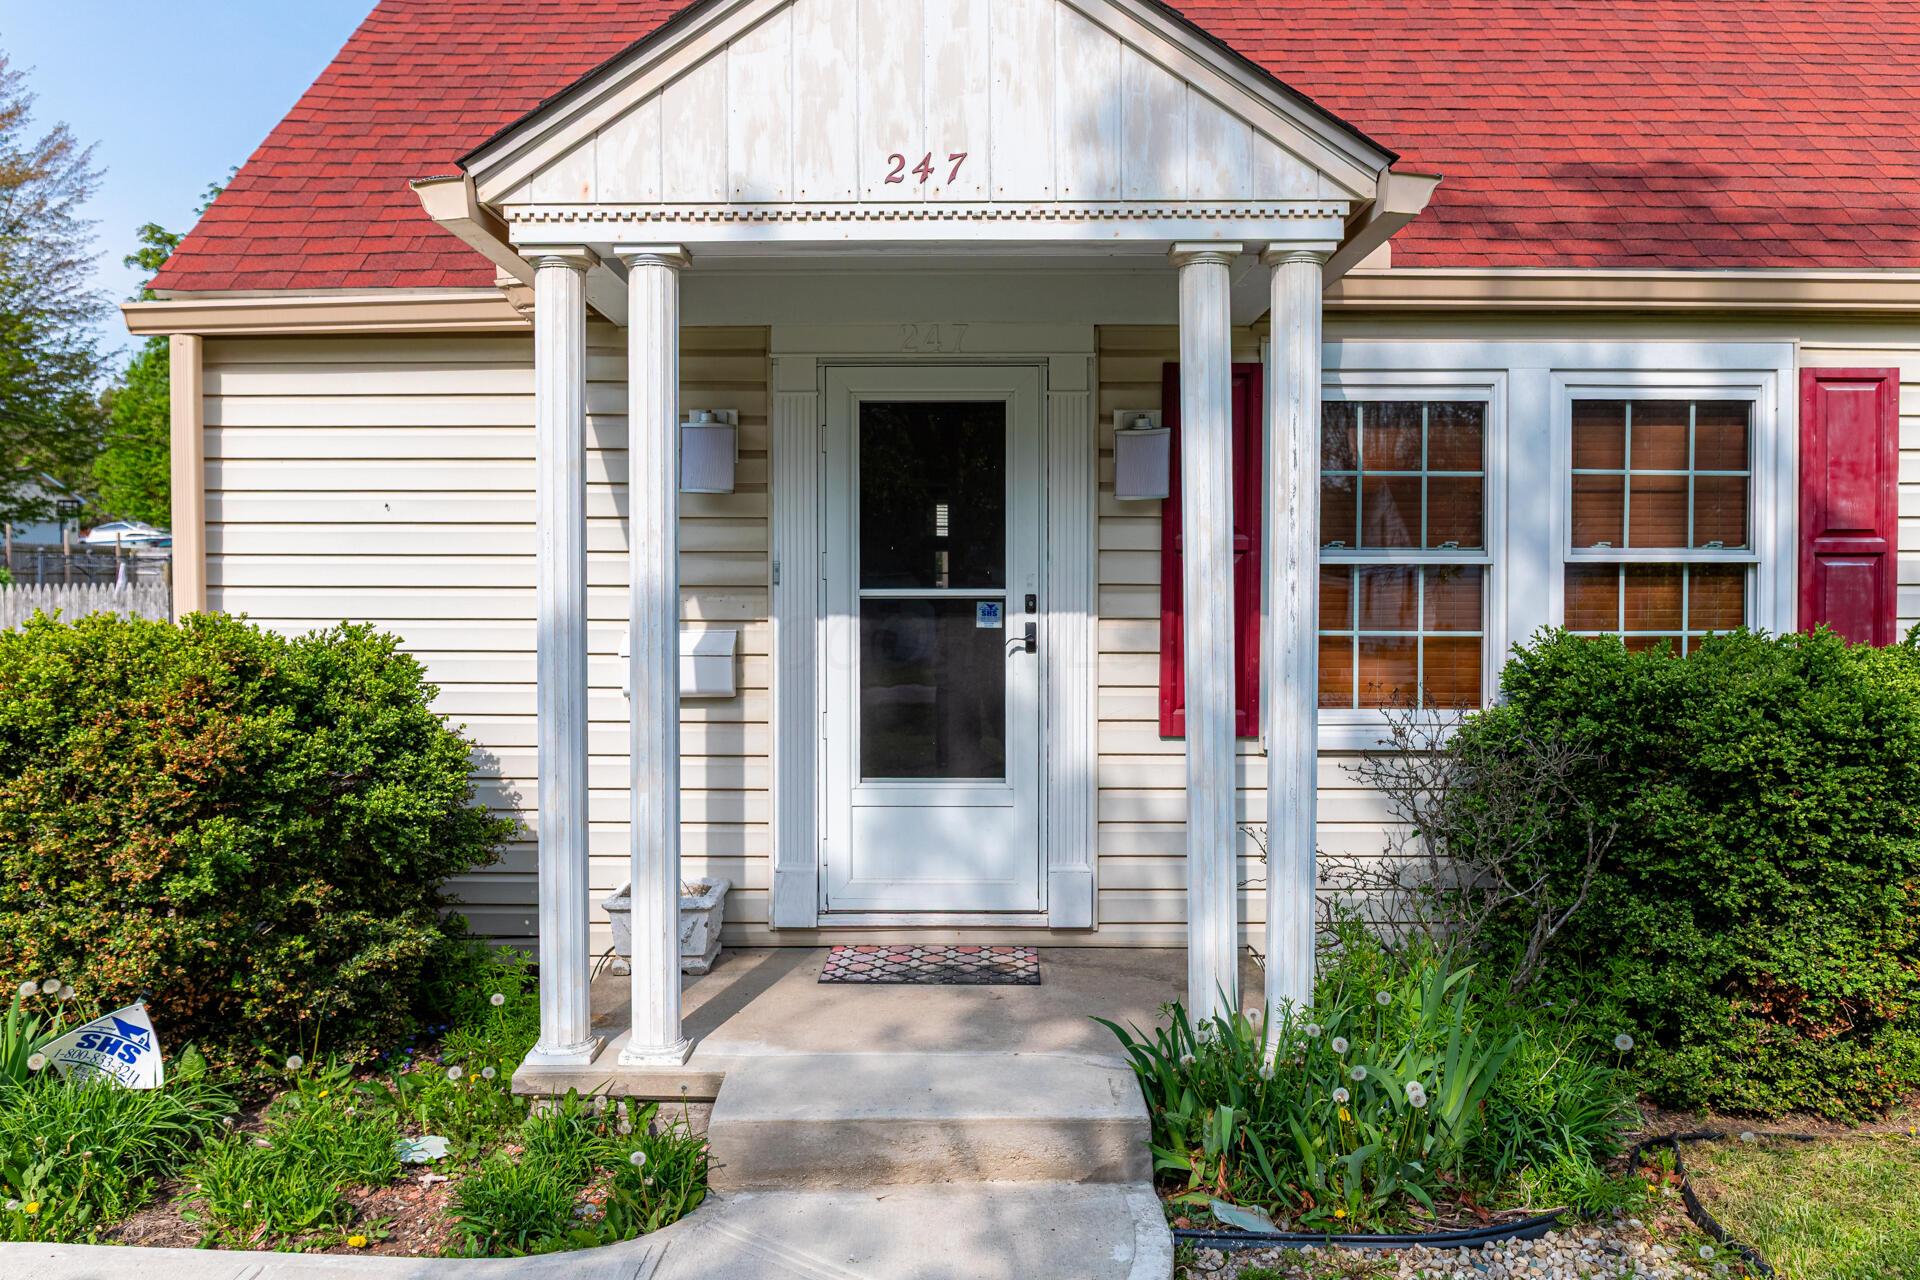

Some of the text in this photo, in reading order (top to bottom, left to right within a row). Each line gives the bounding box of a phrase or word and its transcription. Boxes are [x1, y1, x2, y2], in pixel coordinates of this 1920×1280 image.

[884, 152, 968, 185] 247
[900, 322, 969, 353] 247
[981, 609, 998, 617] SHS
[75, 1033, 142, 1065] SHS
[53, 1048, 140, 1084] 1-800-833-3211
